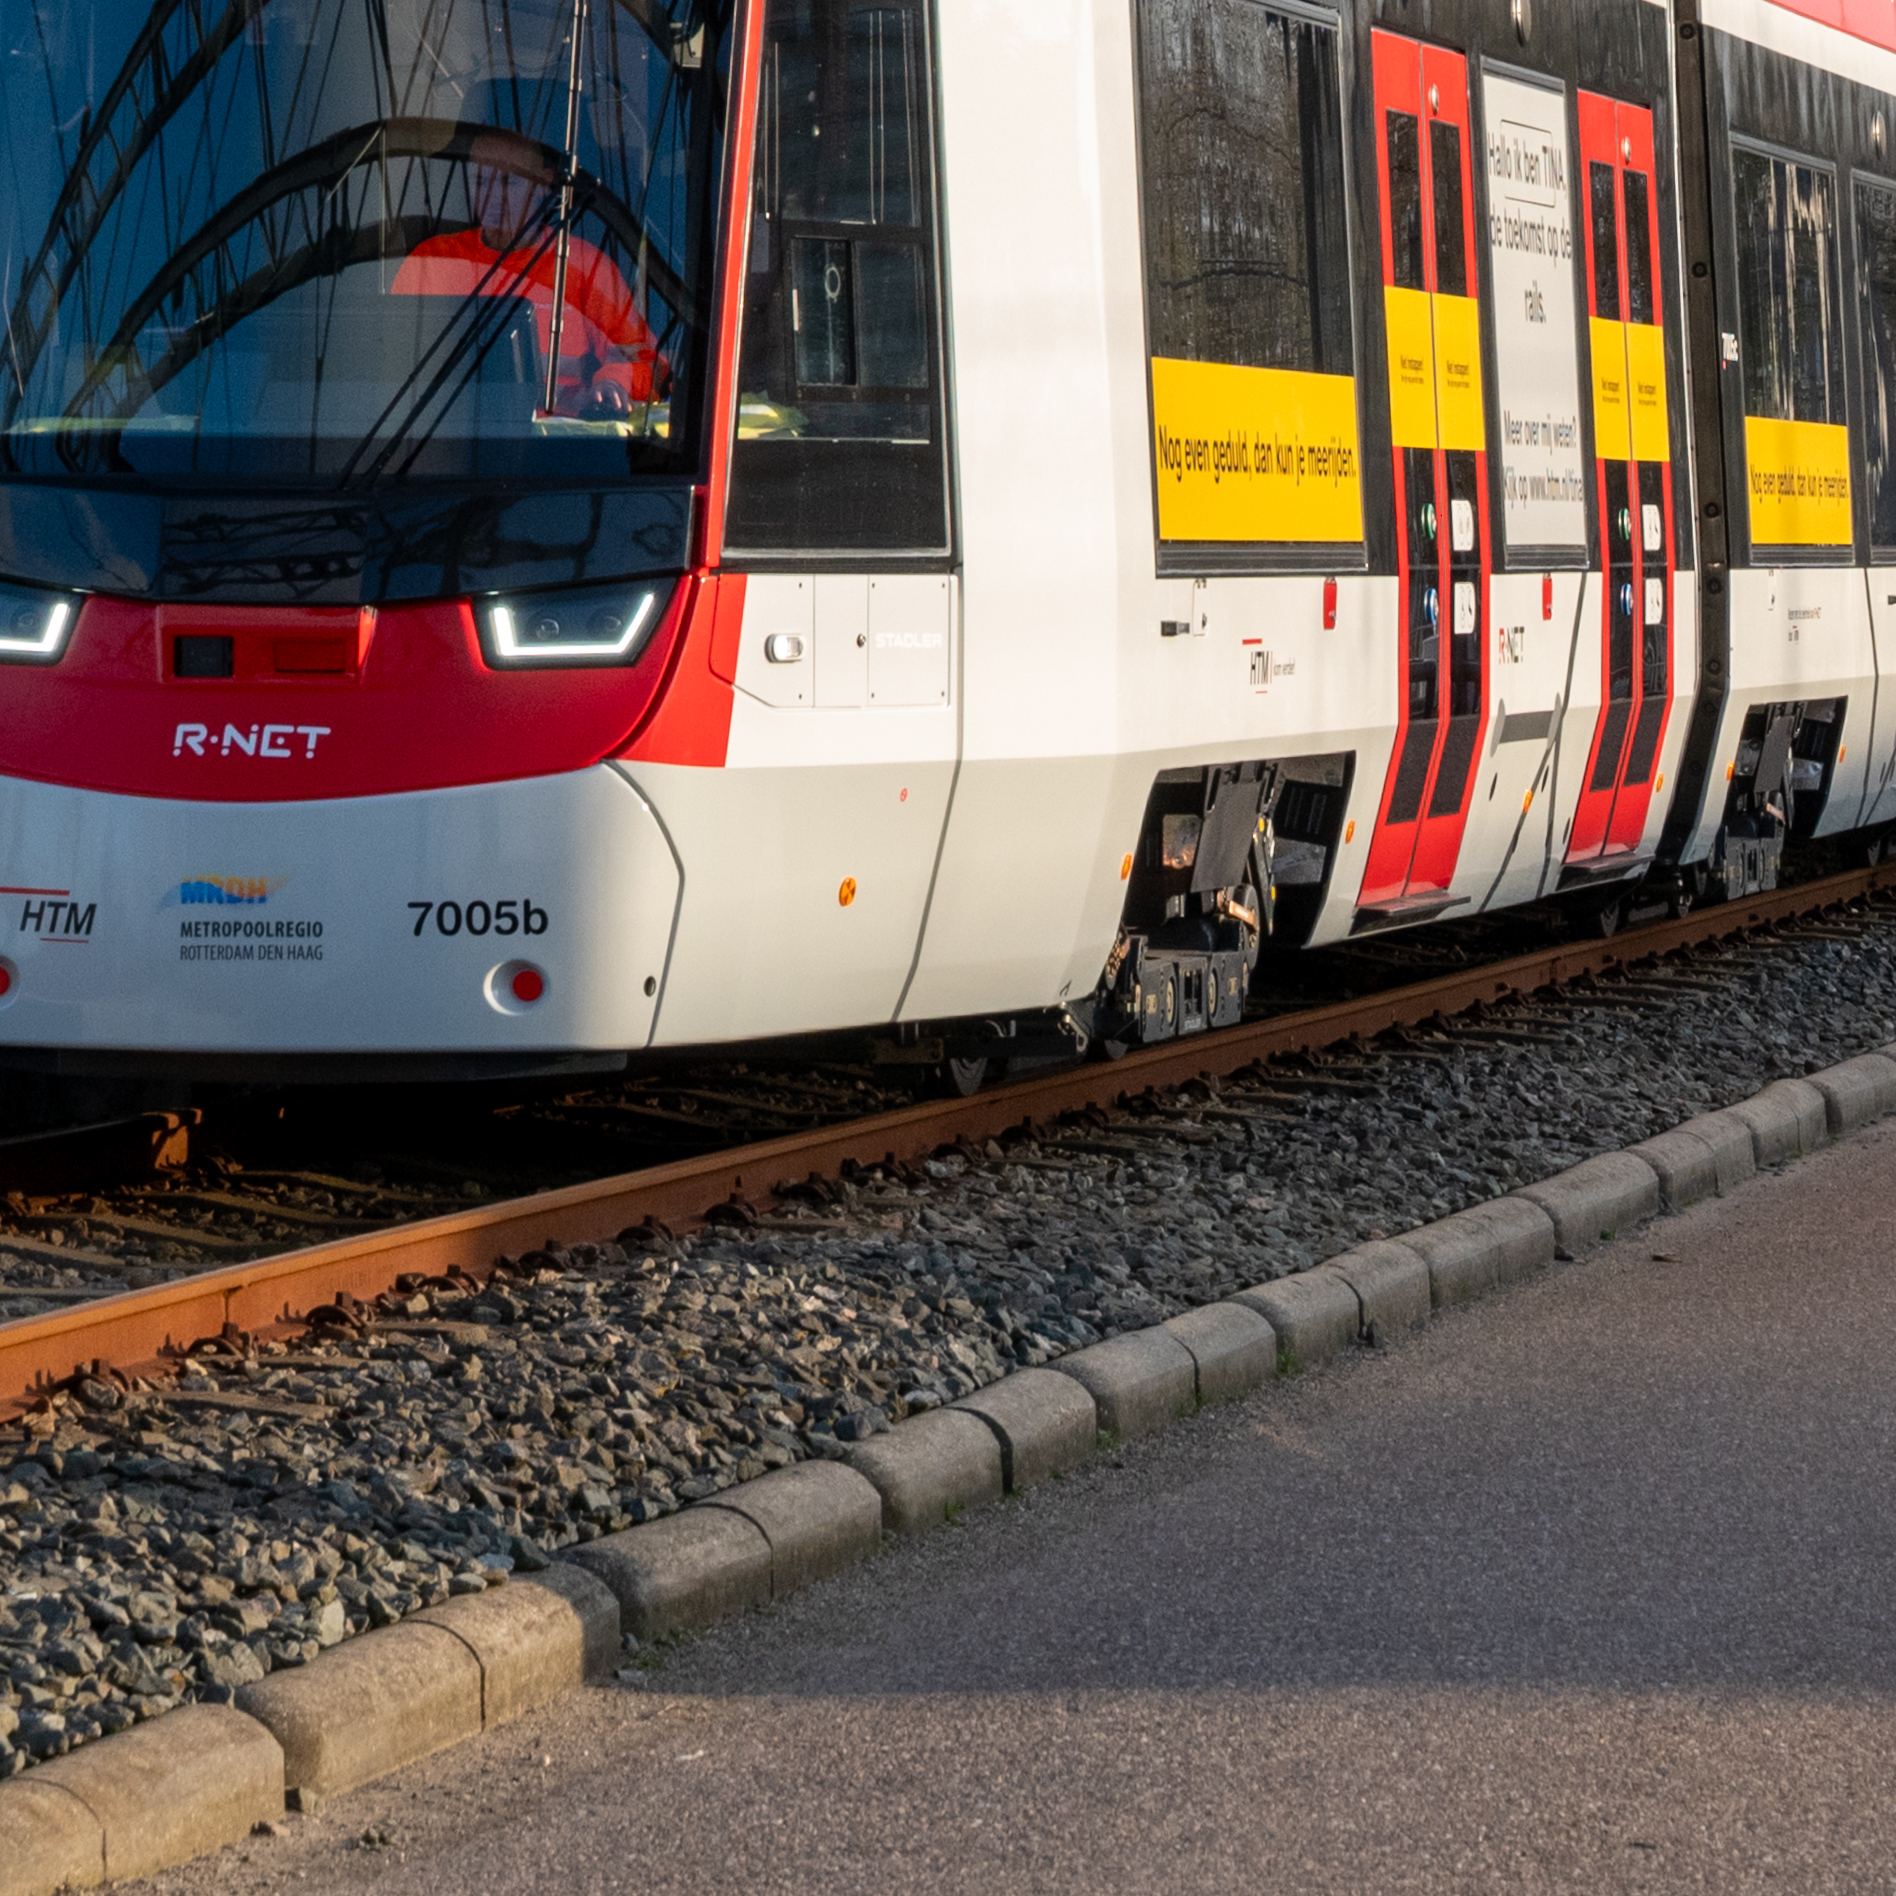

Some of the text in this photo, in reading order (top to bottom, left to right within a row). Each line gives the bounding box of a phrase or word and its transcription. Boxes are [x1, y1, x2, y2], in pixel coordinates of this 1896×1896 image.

[1488, 132, 1512, 180] Hallo
[1513, 137, 1522, 181] ik
[1523, 140, 1541, 186] ben
[1504, 207, 1546, 255] toekomst
[1547, 225, 1558, 268] op
[1159, 424, 1357, 488] Nog even geduld, dan kun je meerijden.
[875, 632, 942, 648] STADLER
[1250, 650, 1269, 685] HTM
[180, 875, 269, 905] MRDH
[19, 899, 97, 936] HTM
[180, 920, 324, 939] METROPOOLREGIO
[407, 898, 549, 937] 7005b
[180, 945, 324, 961] ROTTERDAM DEN HAAG
